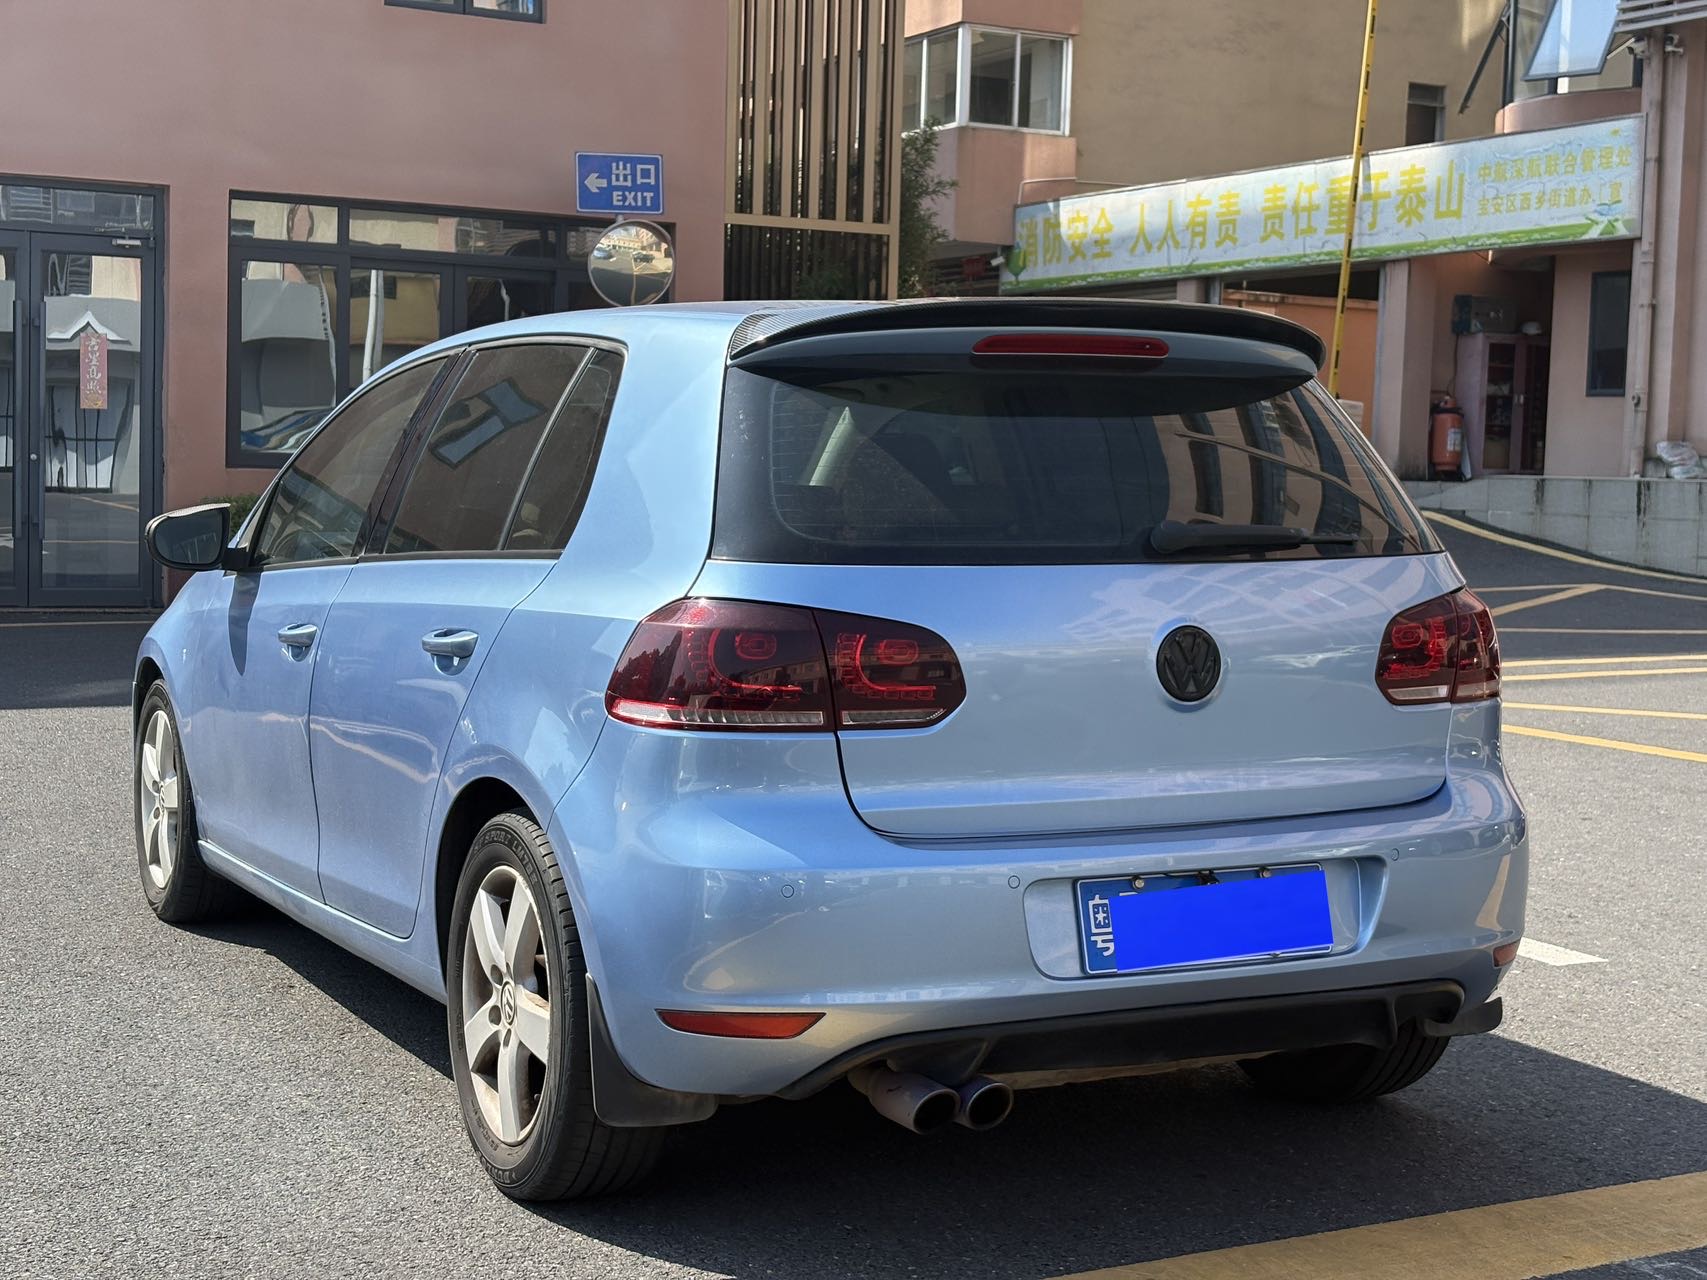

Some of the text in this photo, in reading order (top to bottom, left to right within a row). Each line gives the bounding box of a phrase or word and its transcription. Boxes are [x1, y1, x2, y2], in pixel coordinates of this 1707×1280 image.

[611, 161, 655, 187] 出口
[612, 191, 654, 207] EXIT
[1017, 159, 1465, 269] 消防安全 人人有责 责任重于泰山
[484, 831, 512, 845] SPORT
